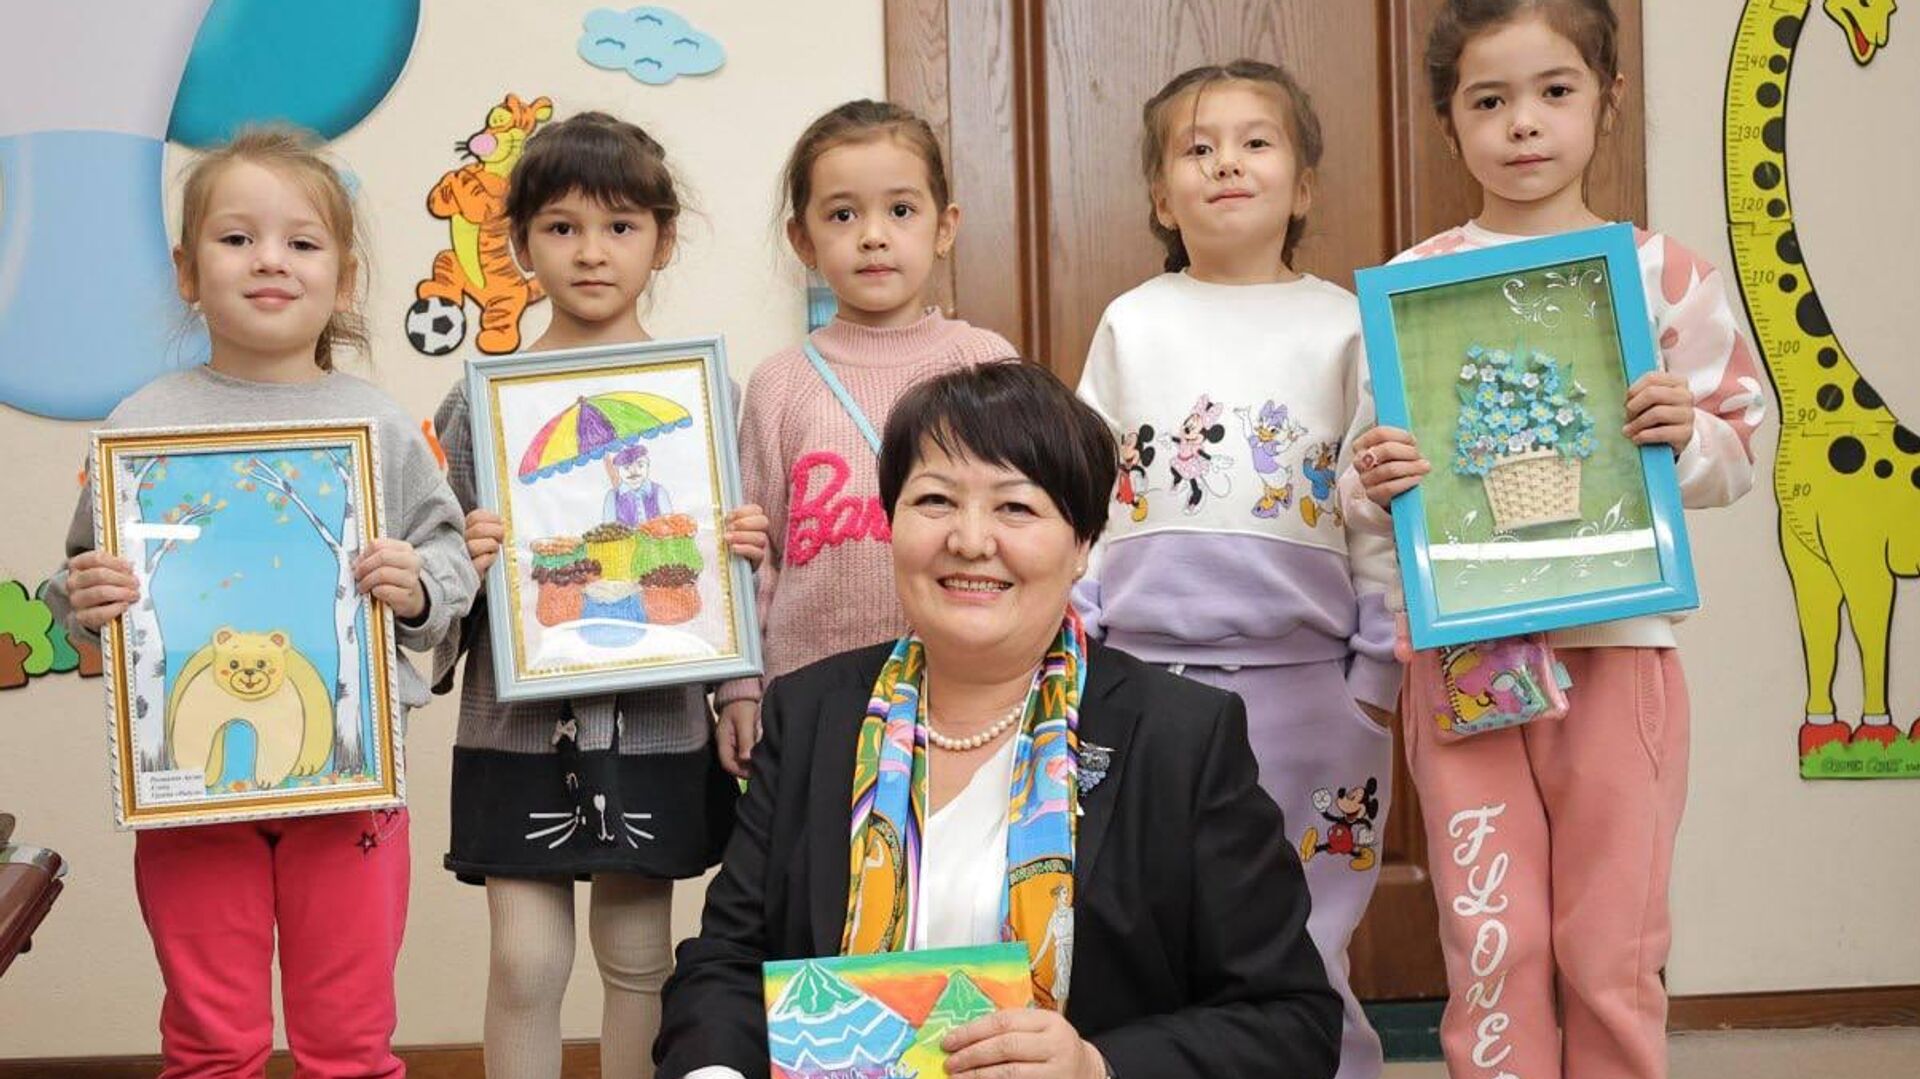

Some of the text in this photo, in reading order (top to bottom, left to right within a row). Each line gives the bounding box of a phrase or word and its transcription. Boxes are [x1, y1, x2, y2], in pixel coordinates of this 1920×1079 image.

[1738, 126, 1760, 139] 130
[1740, 197, 1764, 210] 120
[1752, 270, 1775, 285] 110
[1777, 340, 1800, 355] 100
[1798, 407, 1817, 422] 90
[1792, 482, 1811, 497] 80
[786, 452, 892, 567] Bar
